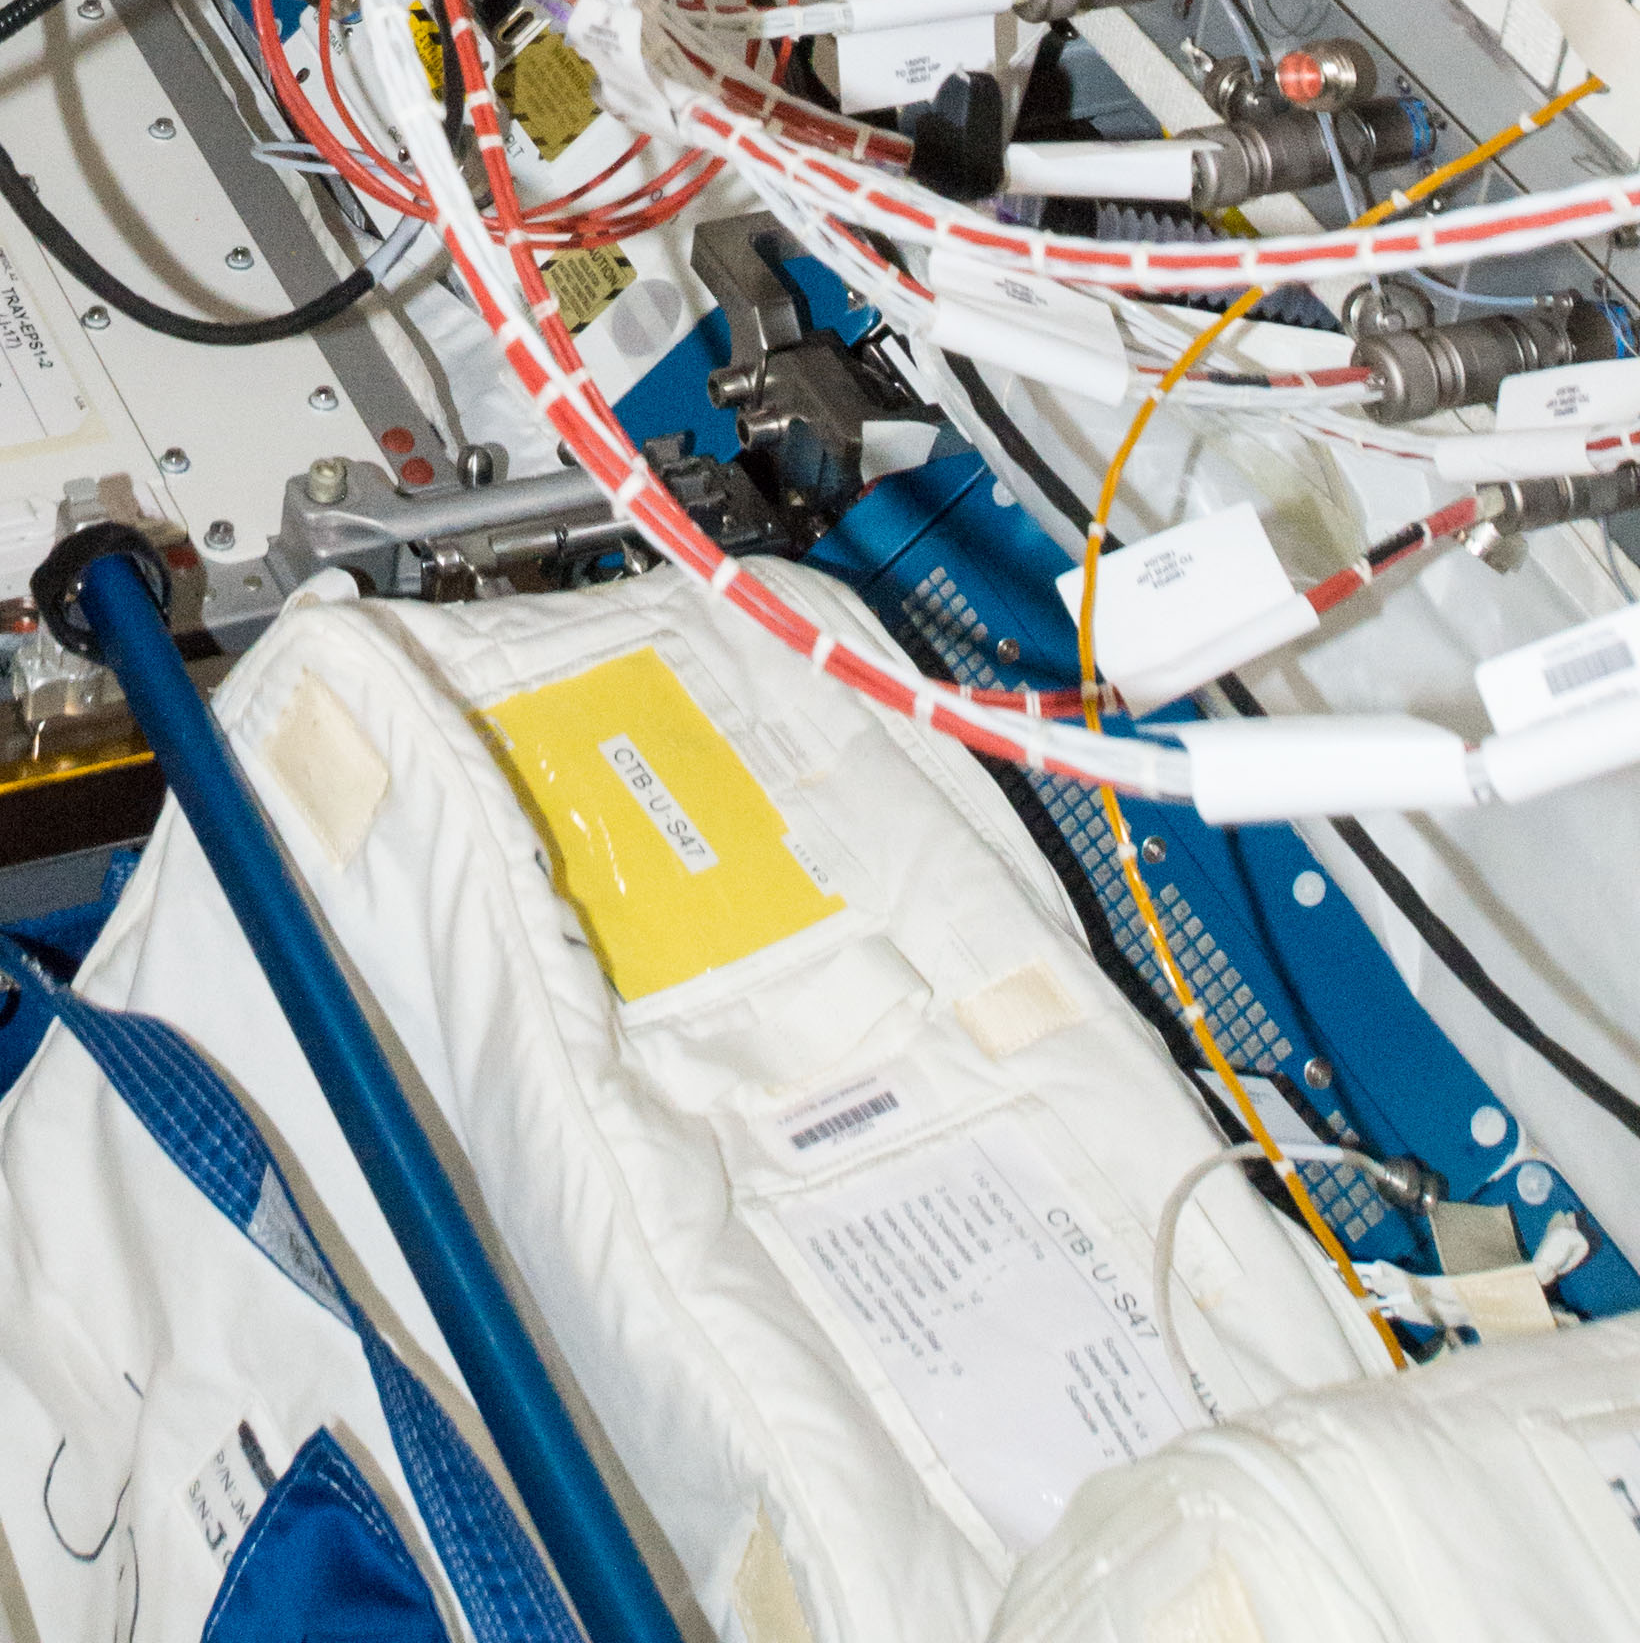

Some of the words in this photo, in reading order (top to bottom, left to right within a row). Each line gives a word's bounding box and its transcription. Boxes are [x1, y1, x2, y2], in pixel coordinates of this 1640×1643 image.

[0, 285, 55, 370] TRAY-EPS1-2
[609, 744, 707, 863] CTB-U-S47
[1040, 1203, 1163, 1345] CTB-U-S47
